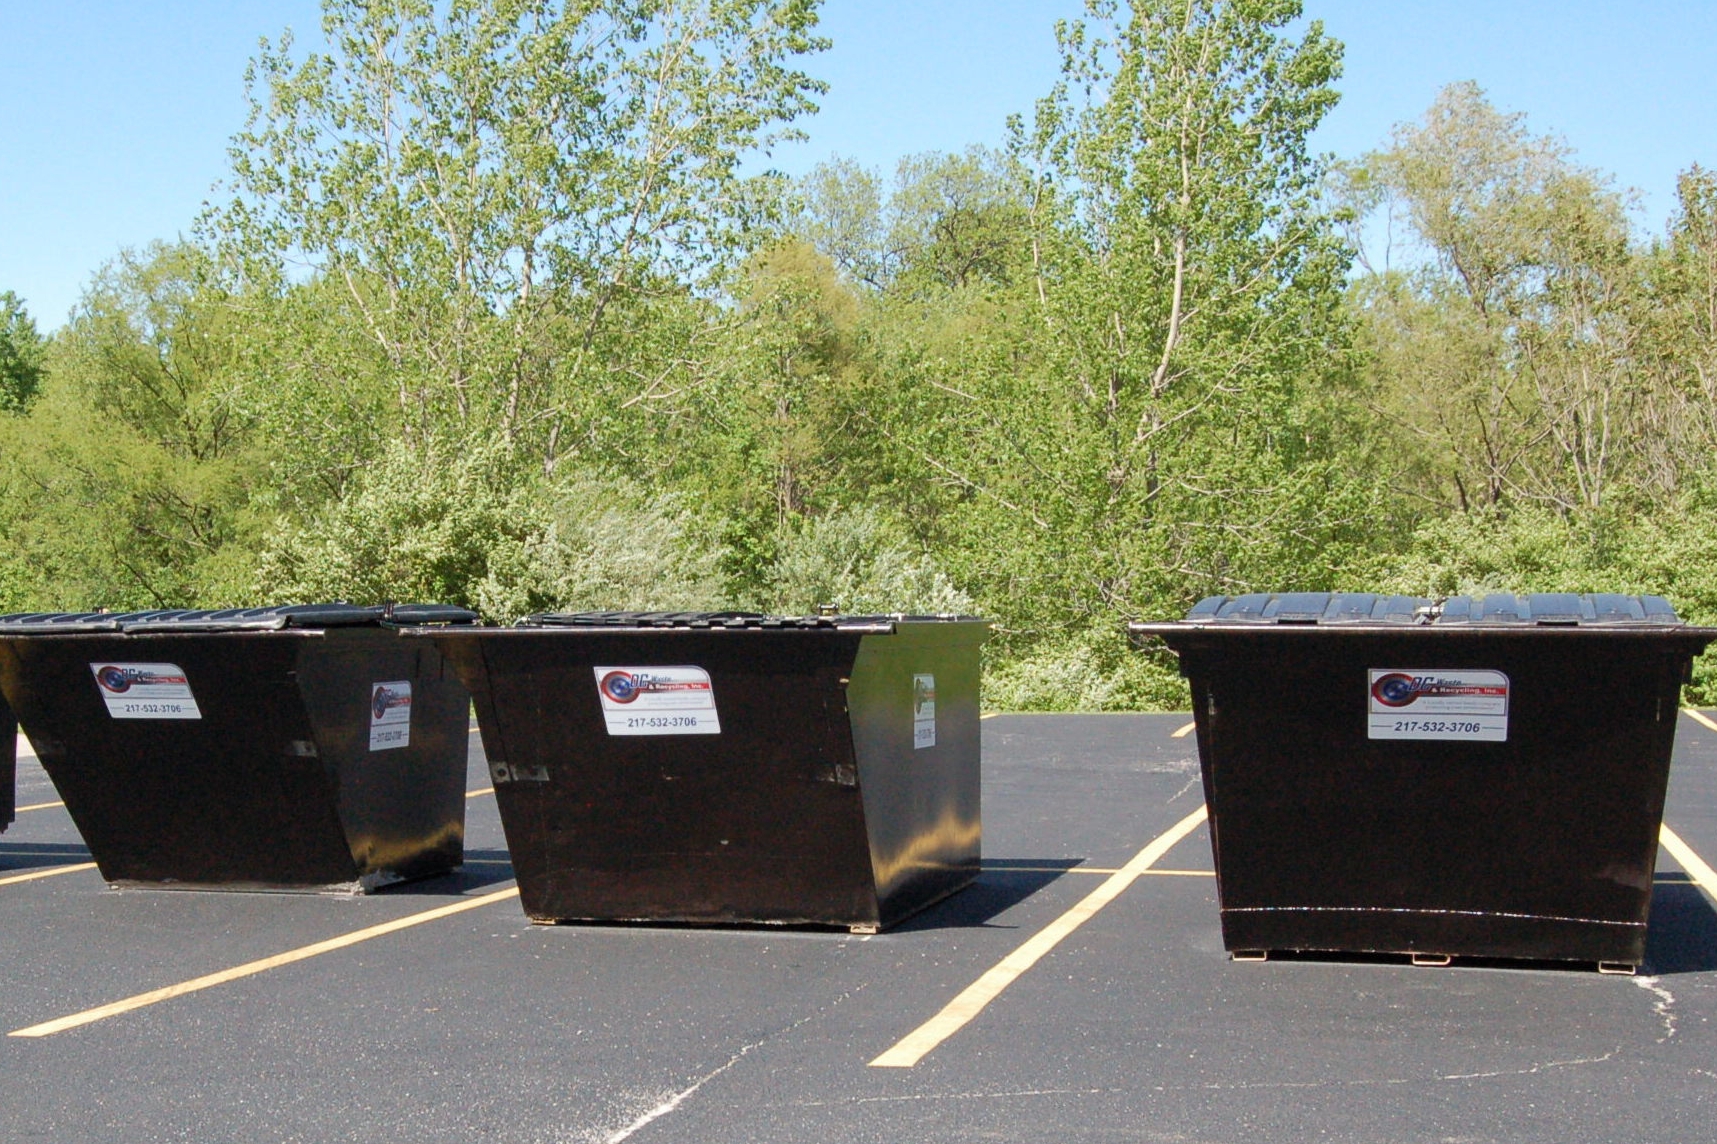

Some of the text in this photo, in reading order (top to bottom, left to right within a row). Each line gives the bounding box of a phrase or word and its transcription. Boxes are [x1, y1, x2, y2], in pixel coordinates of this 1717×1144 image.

[630, 673, 649, 688] DC
[1408, 676, 1463, 691] DC Waste
[125, 704, 181, 713] 217-532-3706
[627, 717, 697, 728] 217-532-3706
[1394, 721, 1480, 733] 217-532-3706
